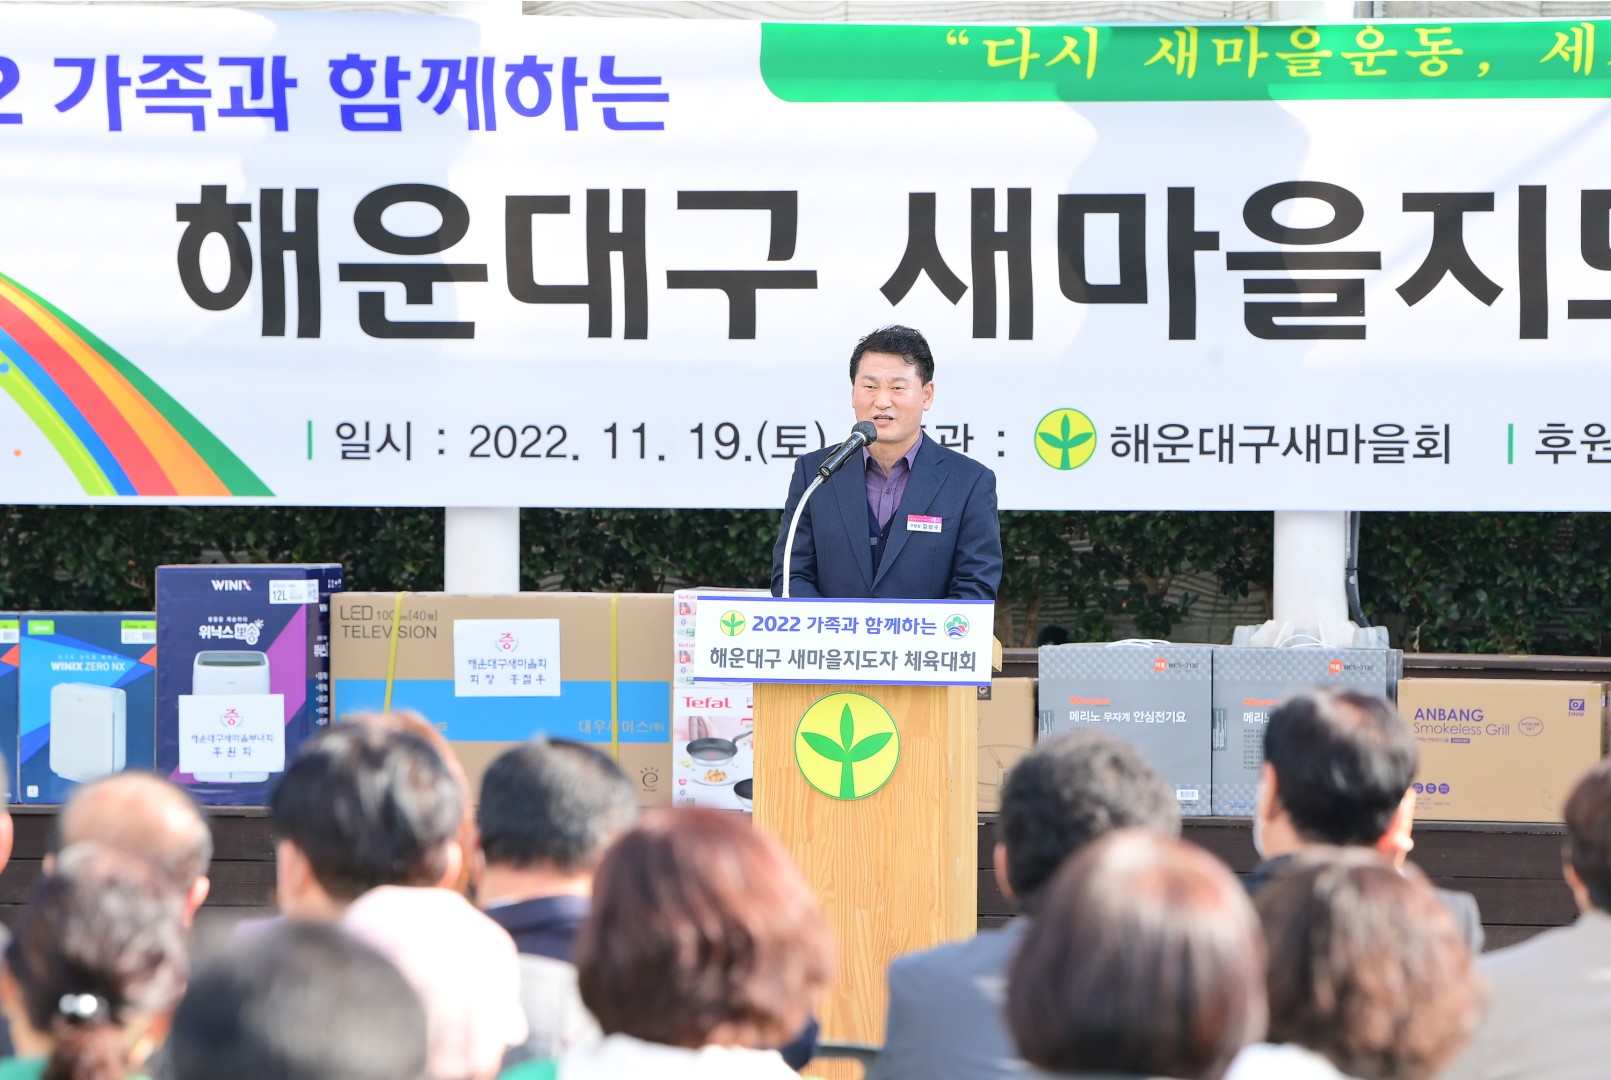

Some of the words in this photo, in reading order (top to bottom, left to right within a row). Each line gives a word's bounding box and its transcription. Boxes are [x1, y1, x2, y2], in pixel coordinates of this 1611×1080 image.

[1144, 24, 1491, 79] 새마을운동,
[53, 54, 297, 131] 가족과
[329, 53, 670, 131] 함께하는
[175, 183, 818, 341] 해운대구
[336, 420, 413, 460] 일시
[469, 425, 580, 460] 2022.
[604, 424, 665, 461] 11.
[690, 420, 826, 464] 19.(토)
[921, 420, 974, 452] 관
[1110, 421, 1452, 465] 해운대구새마을회
[211, 579, 252, 591] WINIX
[341, 605, 373, 620] LED
[341, 625, 437, 638] TELEVSION
[752, 615, 801, 632] 2022
[807, 616, 859, 634] 가족과
[865, 617, 937, 635] 함께하는
[51, 661, 83, 671] WINIX
[85, 661, 110, 671] ZERO
[710, 648, 782, 669] 해운대구
[788, 649, 898, 671] 새마을지도자
[904, 650, 976, 672] 체육대회
[683, 697, 732, 708] Tefal
[1069, 710, 1101, 722] 메리노
[1133, 711, 1187, 723] 안심전기요
[1414, 708, 1484, 722] ANBANG
[1414, 722, 1482, 736] Smokeless
[1485, 723, 1510, 736] Grill
